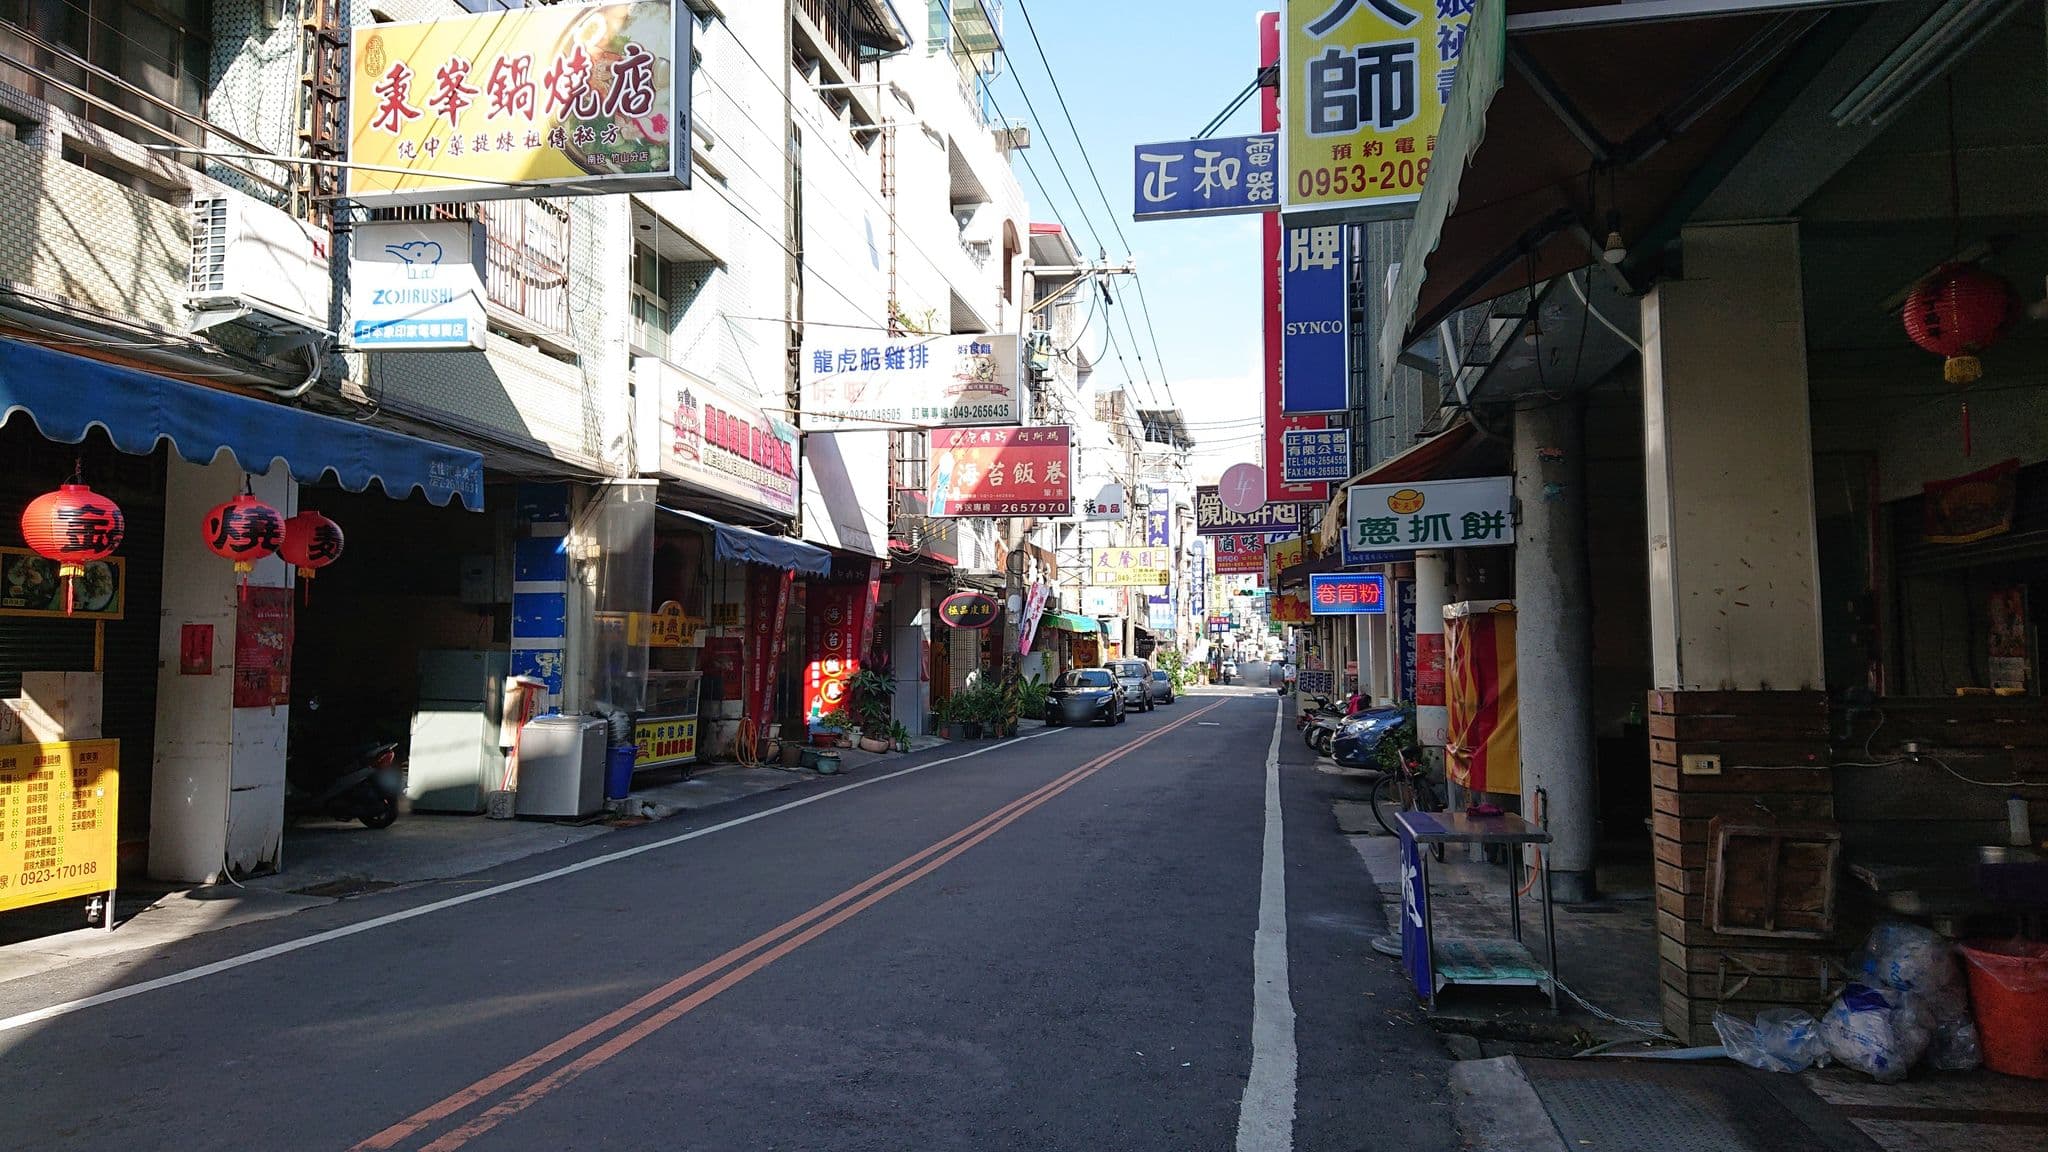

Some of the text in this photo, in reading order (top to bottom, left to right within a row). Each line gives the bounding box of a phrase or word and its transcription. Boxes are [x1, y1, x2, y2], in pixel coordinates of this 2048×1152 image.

[1140, 148, 1241, 202] 正和
[1246, 137, 1275, 202] 電器
[1286, 319, 1344, 336] SYNCO
[1287, 433, 1345, 445] 正和電器
[1287, 444, 1346, 457] 有限公司
[1001, 503, 1066, 513] 2657970
[210, 504, 286, 553] 燒
[1317, 583, 1381, 604] 卷筒粉
[21, 861, 97, 886] 0923-170188
